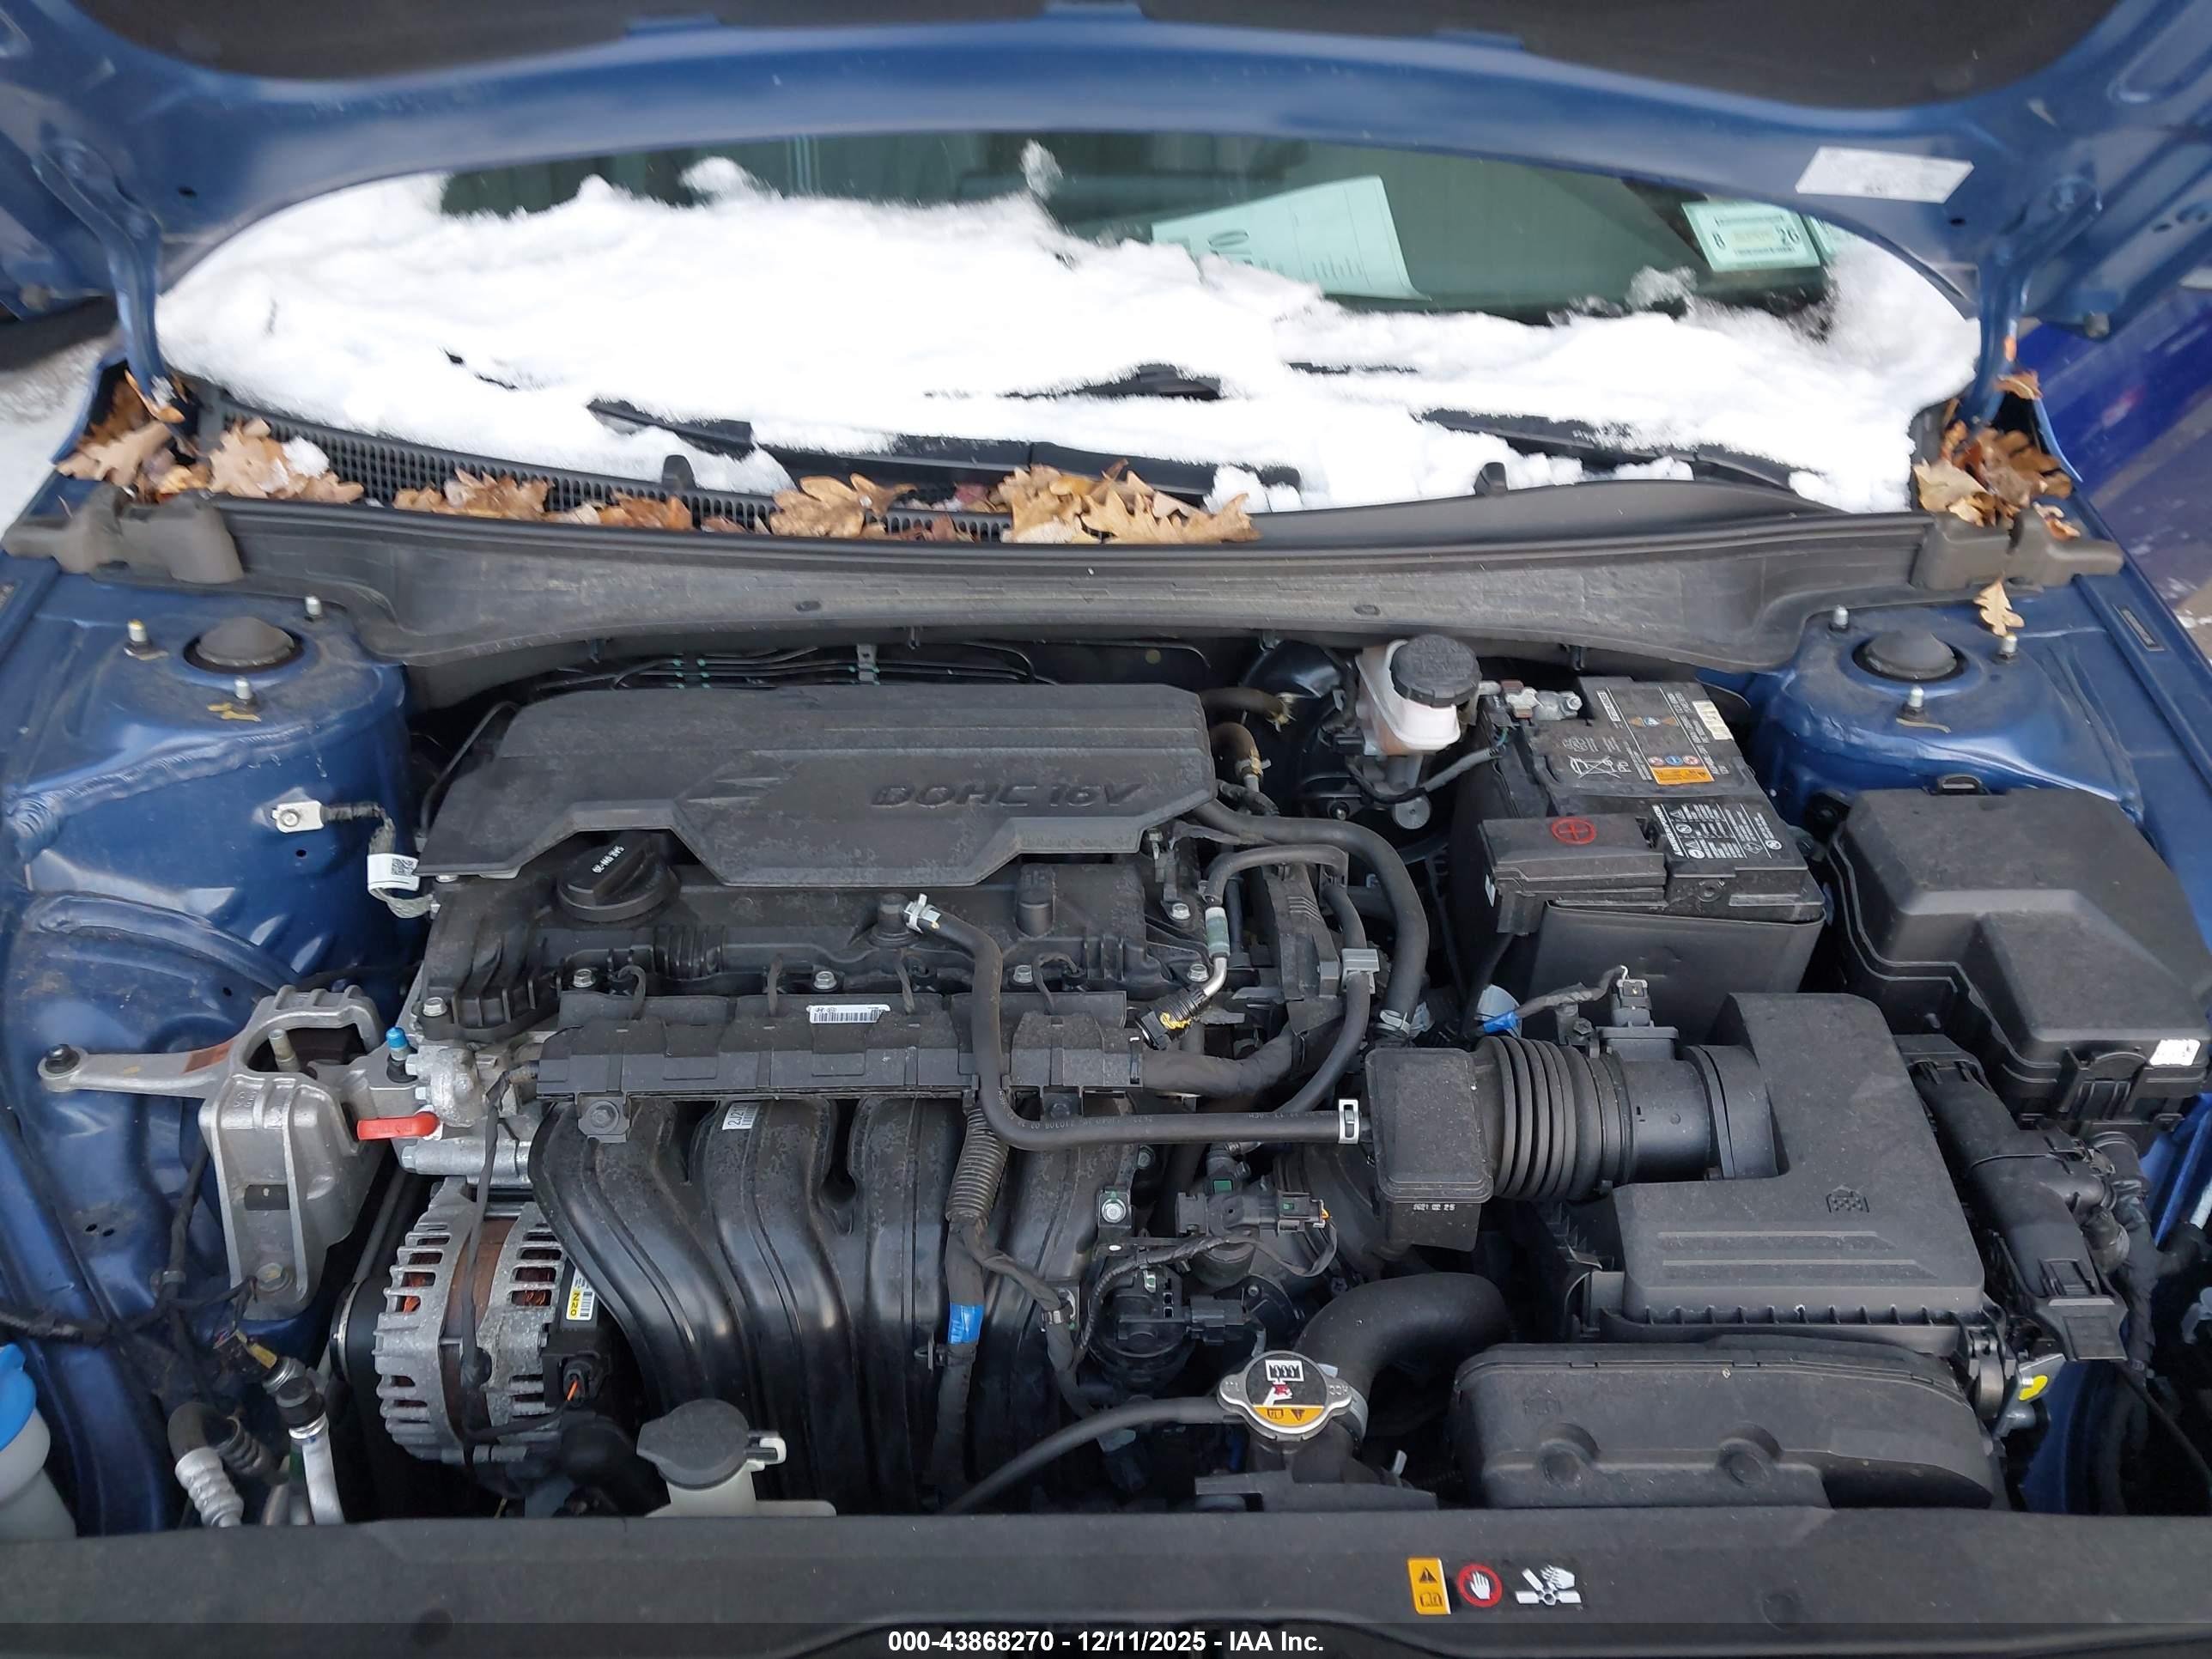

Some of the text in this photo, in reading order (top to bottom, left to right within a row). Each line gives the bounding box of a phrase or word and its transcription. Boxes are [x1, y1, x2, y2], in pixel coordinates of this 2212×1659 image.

[872, 782, 1145, 809] DOHC 16V
[592, 845, 625, 873] SAE 0W-20
